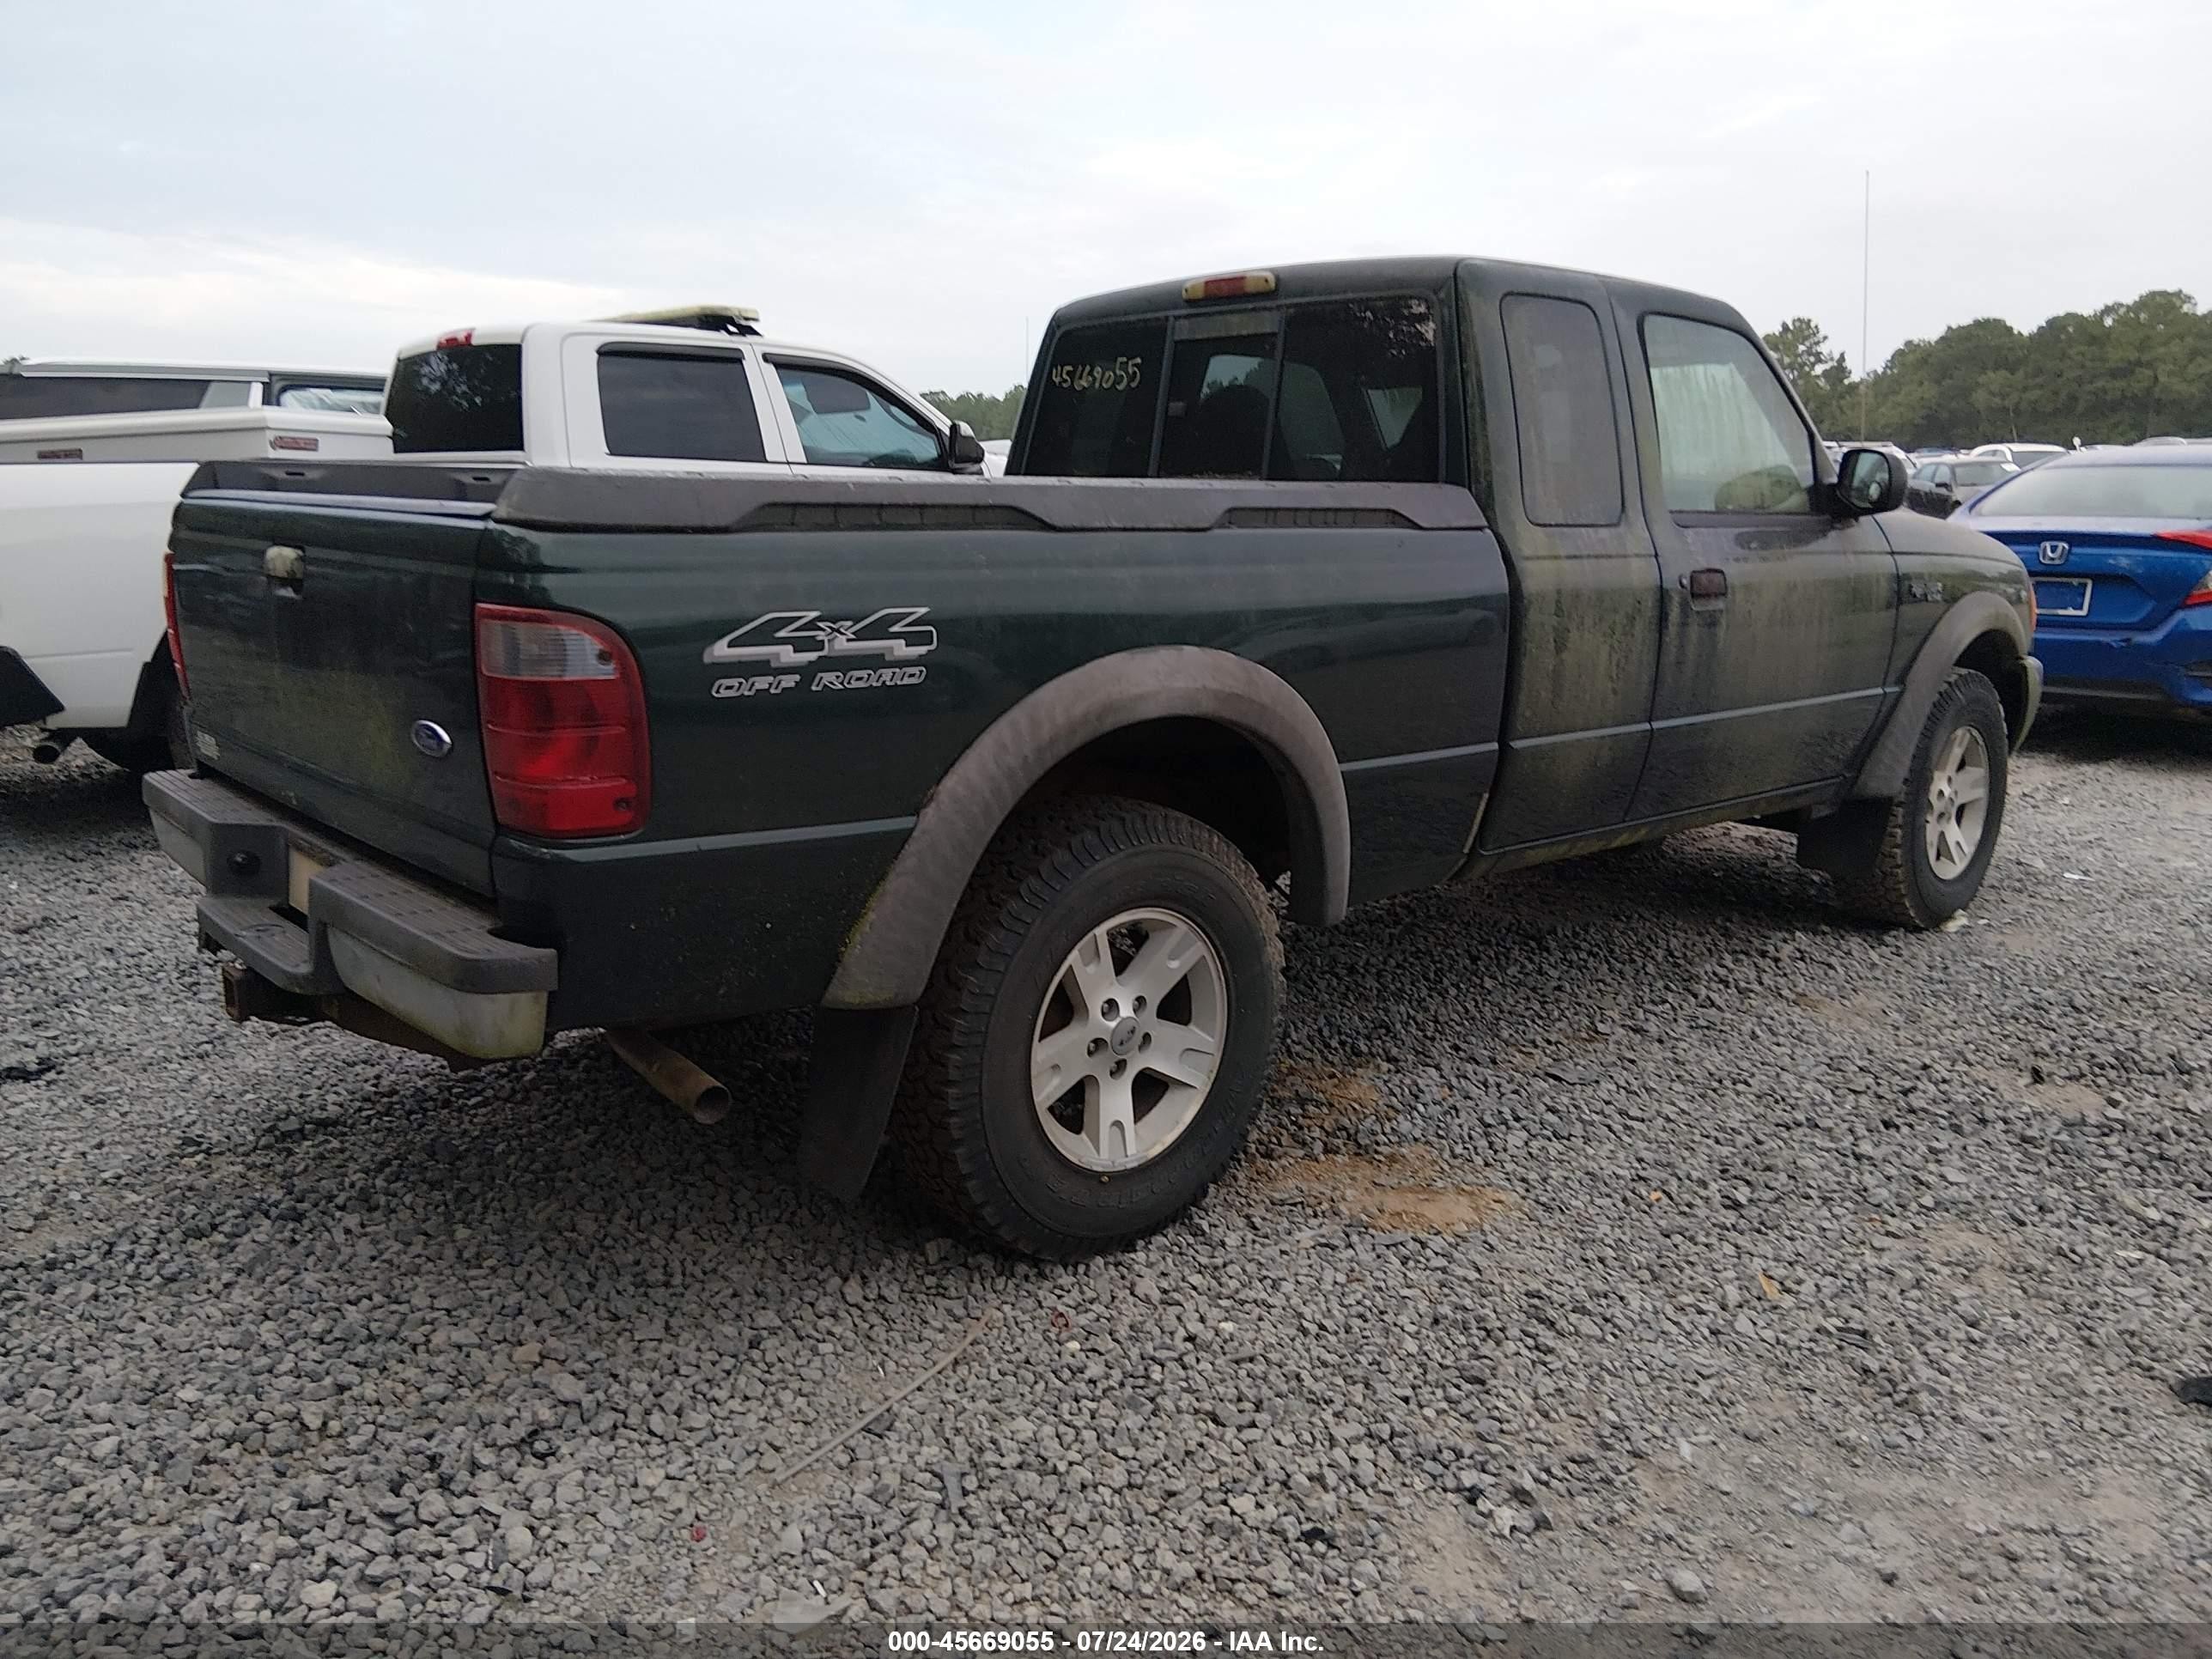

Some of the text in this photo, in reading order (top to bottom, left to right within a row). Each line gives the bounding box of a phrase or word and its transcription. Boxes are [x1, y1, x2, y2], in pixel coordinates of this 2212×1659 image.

[1052, 356, 1142, 392] 45669055
[711, 666, 927, 697] OFF ROAD
